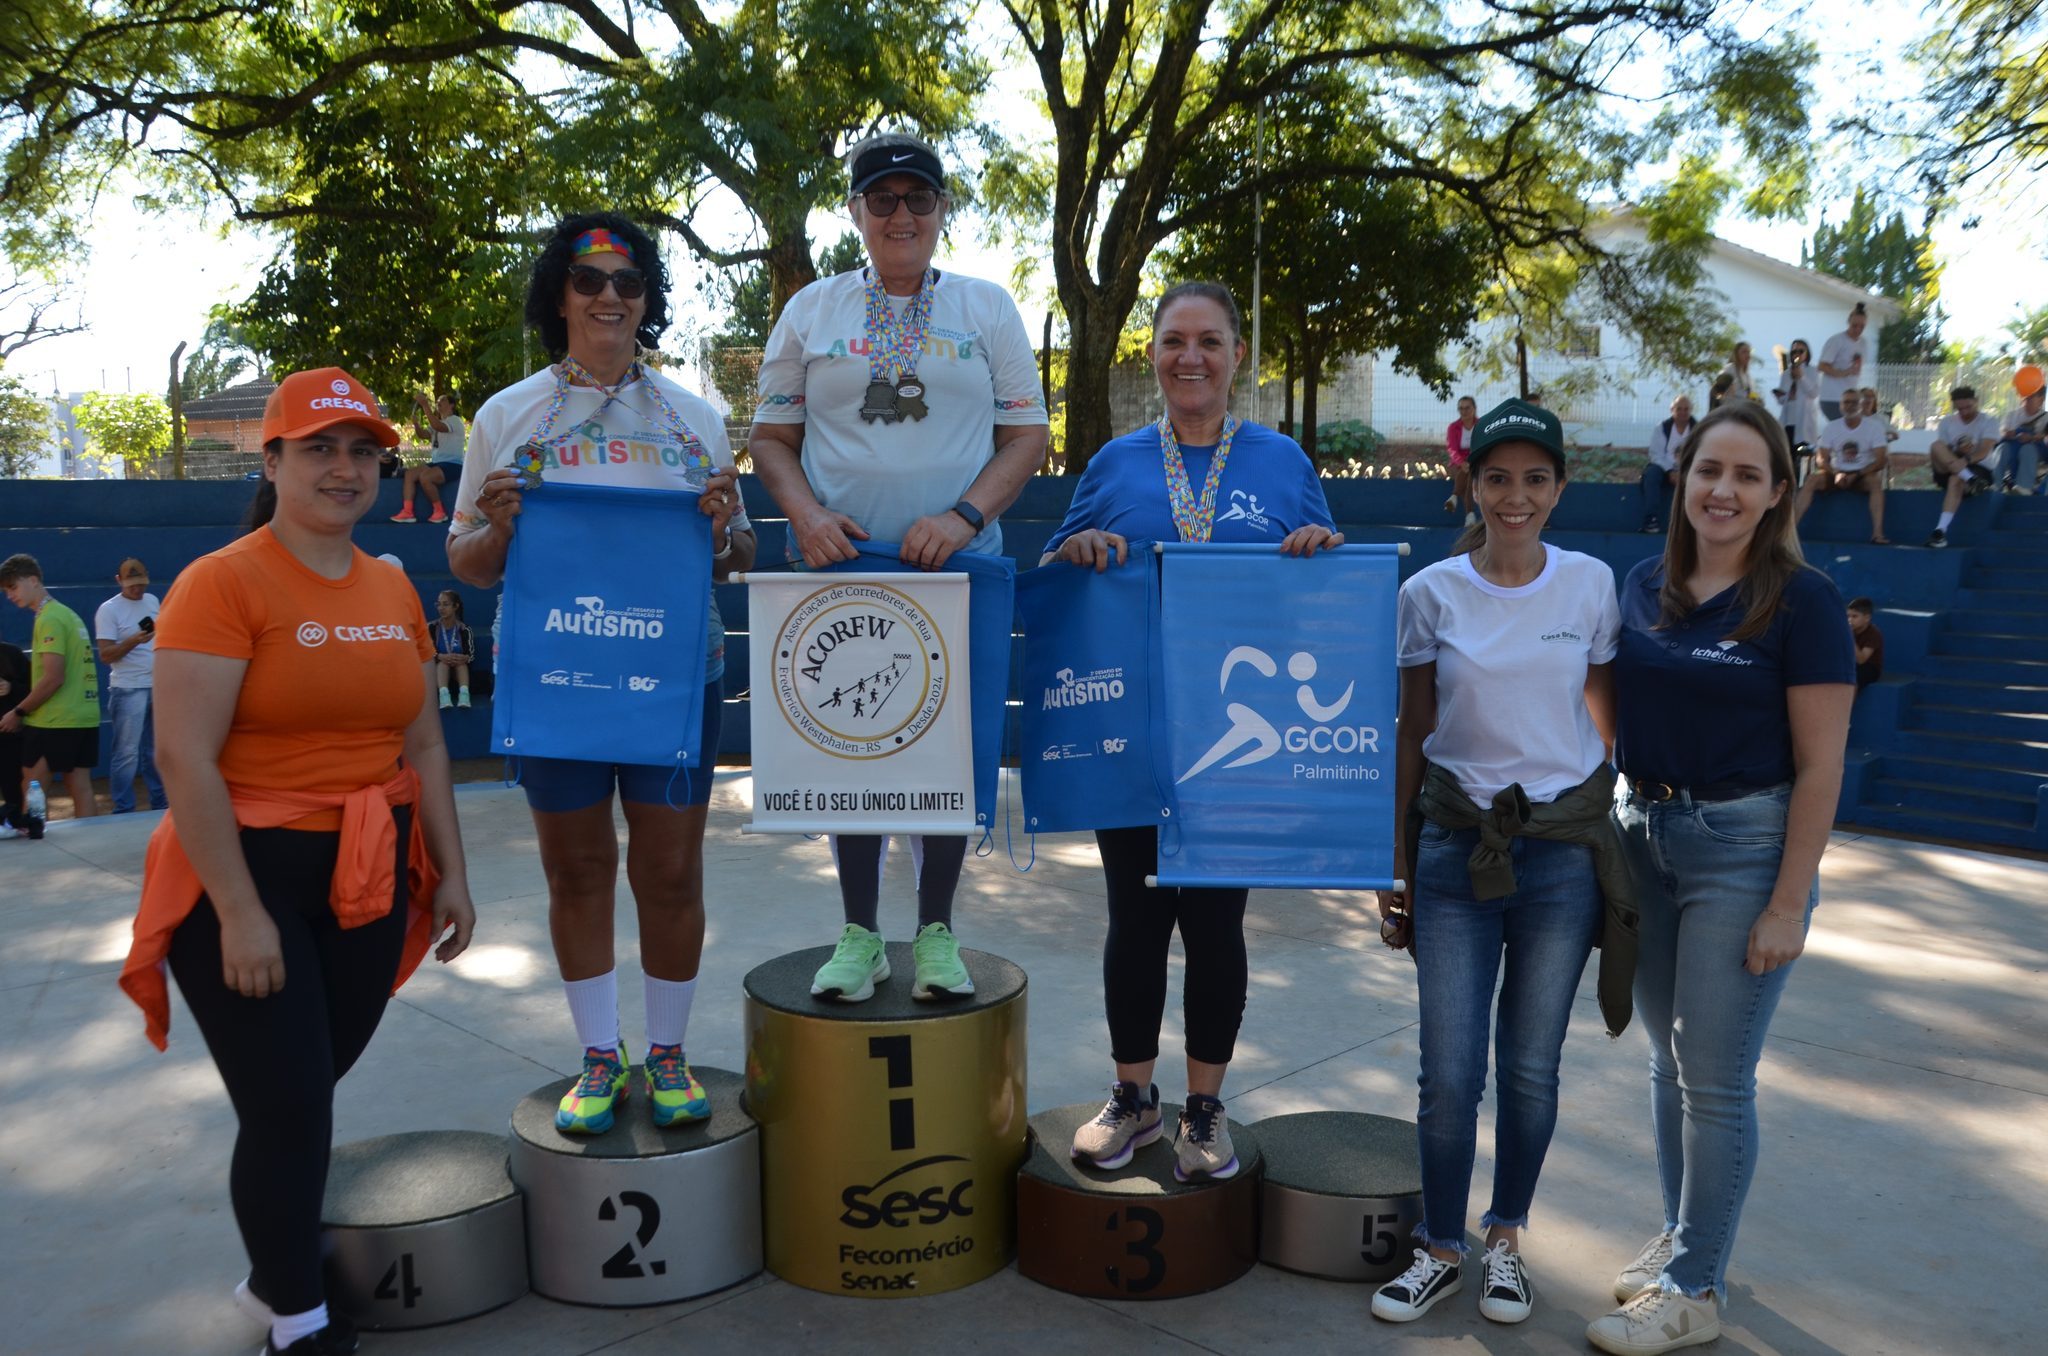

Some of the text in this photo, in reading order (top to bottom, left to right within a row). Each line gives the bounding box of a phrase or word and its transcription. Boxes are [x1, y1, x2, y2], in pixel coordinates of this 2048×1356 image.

[310, 397, 371, 417] CRESOL
[1484, 414, 1547, 434] Casa Branca
[1246, 511, 1269, 527] GCOR
[544, 608, 663, 640] Autismo
[784, 586, 932, 643] Associação de Corredores de Rua
[335, 625, 410, 642] CRESOL
[801, 615, 896, 684] ACORFW
[779, 666, 800, 719] Frederico
[907, 675, 944, 736] Desde 2024
[1042, 679, 1125, 711] Autismo
[1284, 726, 1379, 754] GCOR
[1293, 763, 1380, 781] Palmitinho
[764, 789, 964, 811] VOCÊ É O SEU ÚNICO LIMITE!
[598, 1190, 667, 1280] 2
[839, 1235, 975, 1266] Fecomércio
[1105, 1206, 1166, 1293] 3
[1360, 1213, 1399, 1266] 5
[374, 1253, 423, 1309] 4
[841, 1270, 917, 1291] Senac
